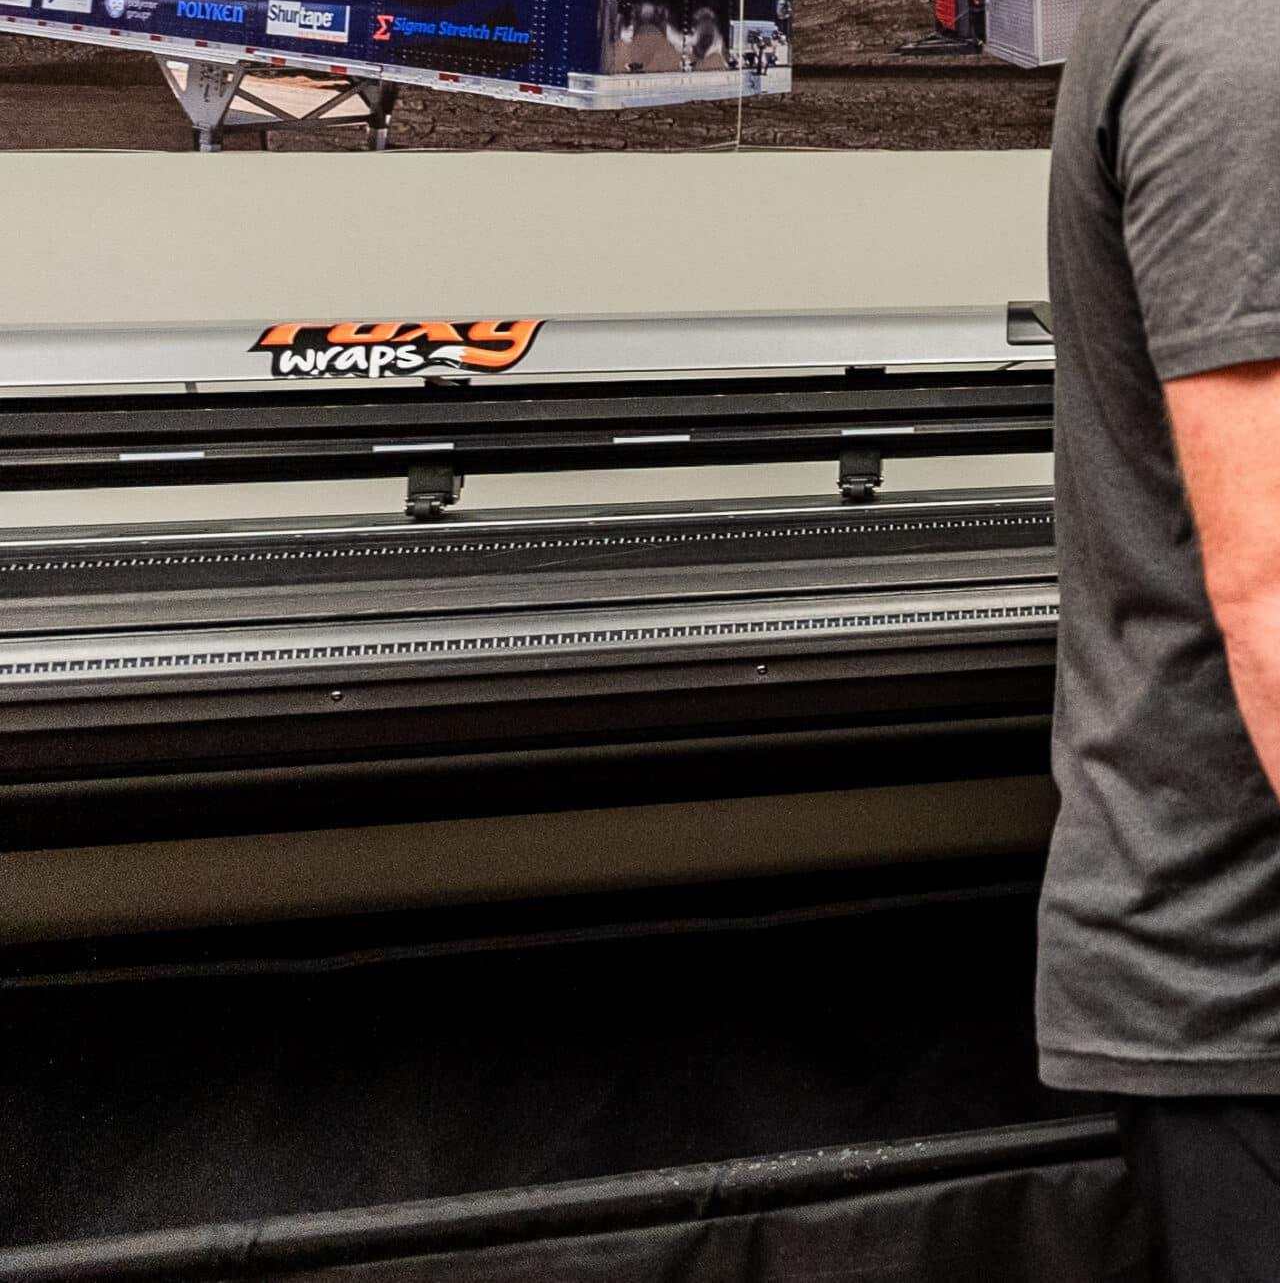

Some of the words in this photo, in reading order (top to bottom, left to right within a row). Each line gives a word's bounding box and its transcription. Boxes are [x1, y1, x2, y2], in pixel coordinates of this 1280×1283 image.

[267, 4, 334, 30] Shurtape
[393, 16, 437, 37] Sigma
[438, 20, 492, 39] Stretch
[493, 25, 530, 44] Film
[280, 344, 424, 378] wraps
